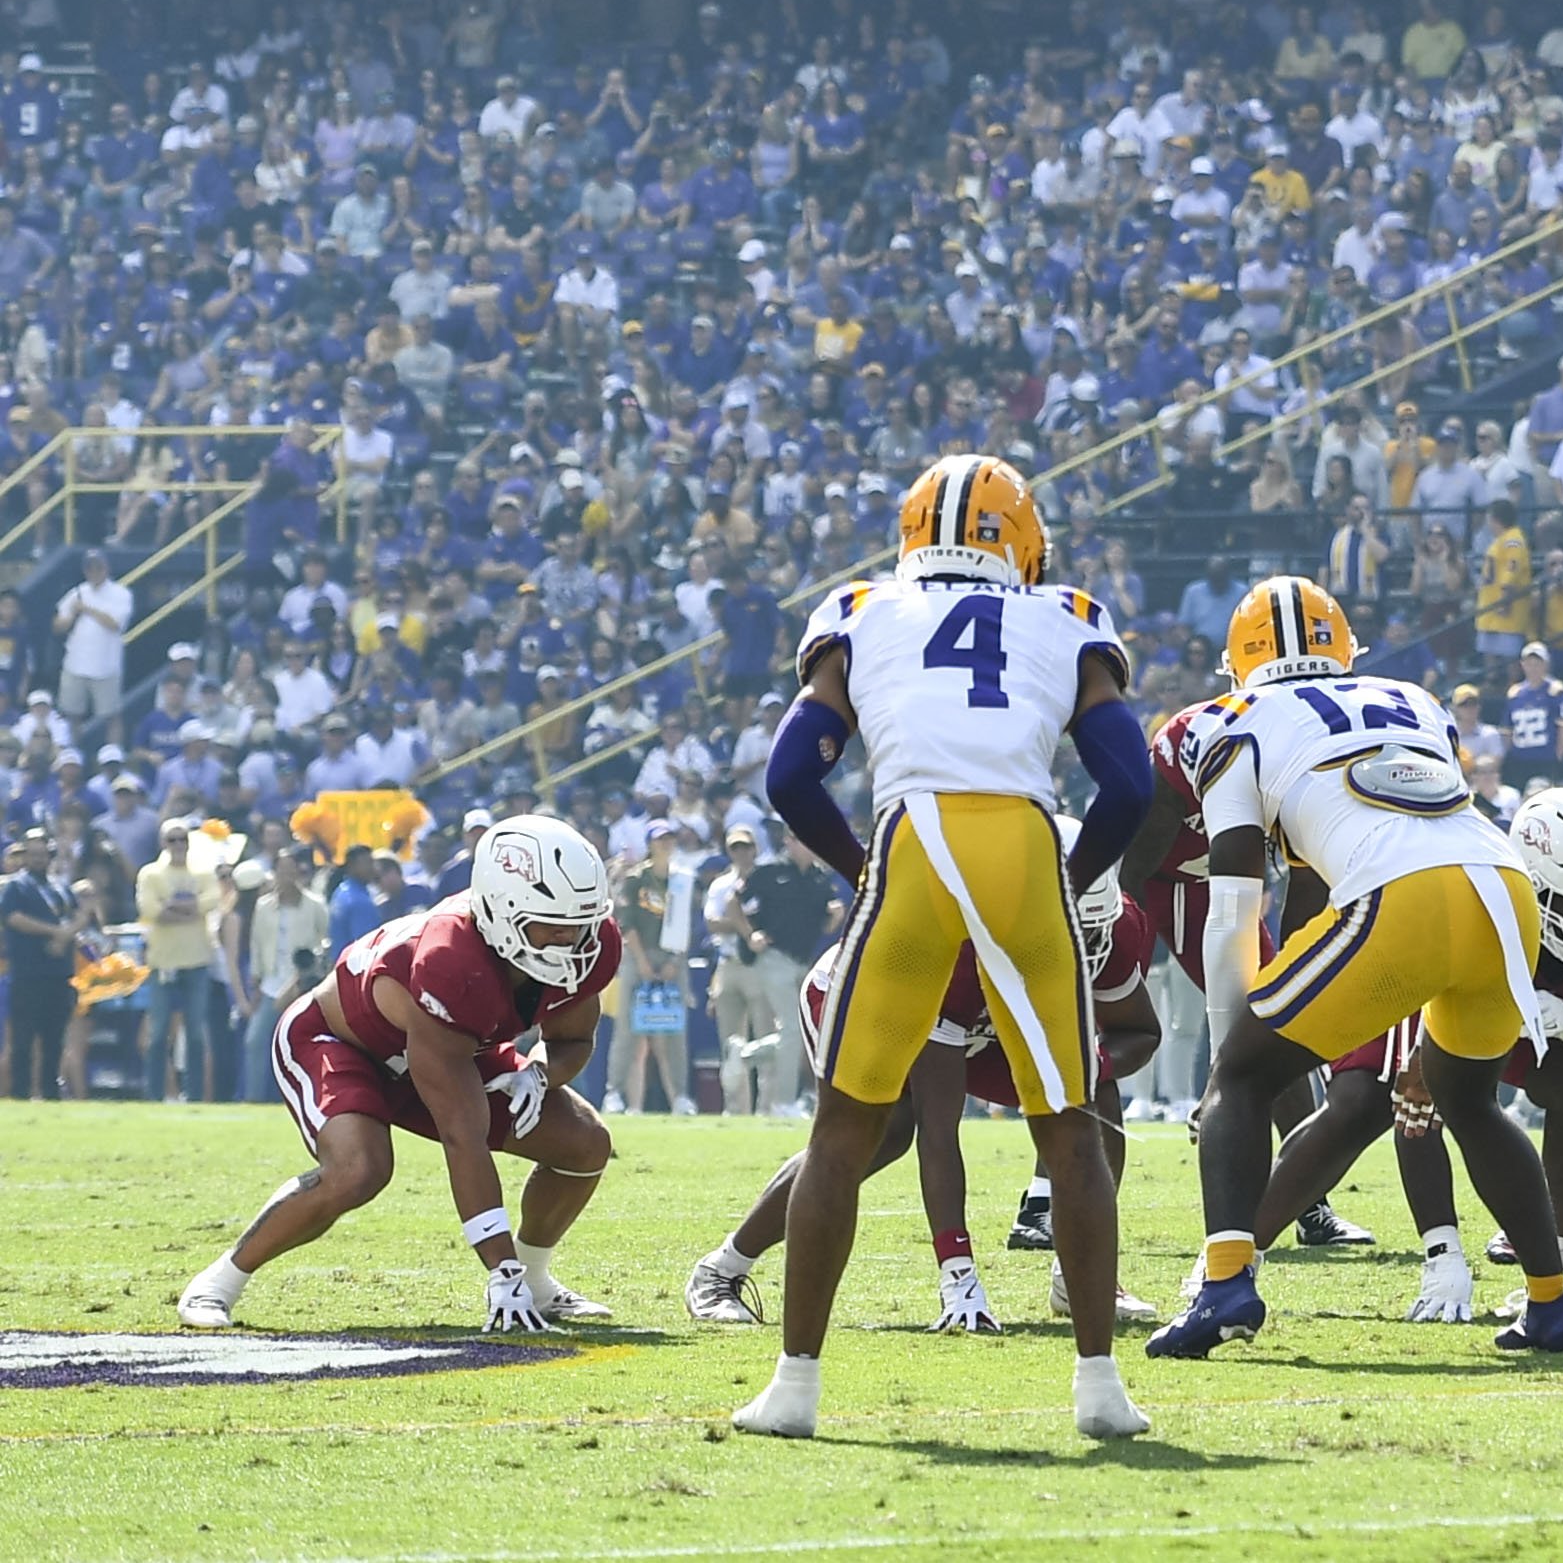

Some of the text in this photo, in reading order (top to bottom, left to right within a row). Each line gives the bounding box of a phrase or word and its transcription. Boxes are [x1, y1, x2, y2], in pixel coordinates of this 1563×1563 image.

[923, 594, 1009, 709] 4
[1264, 660, 1331, 677] TIGERS
[1510, 708, 1550, 749] 22
